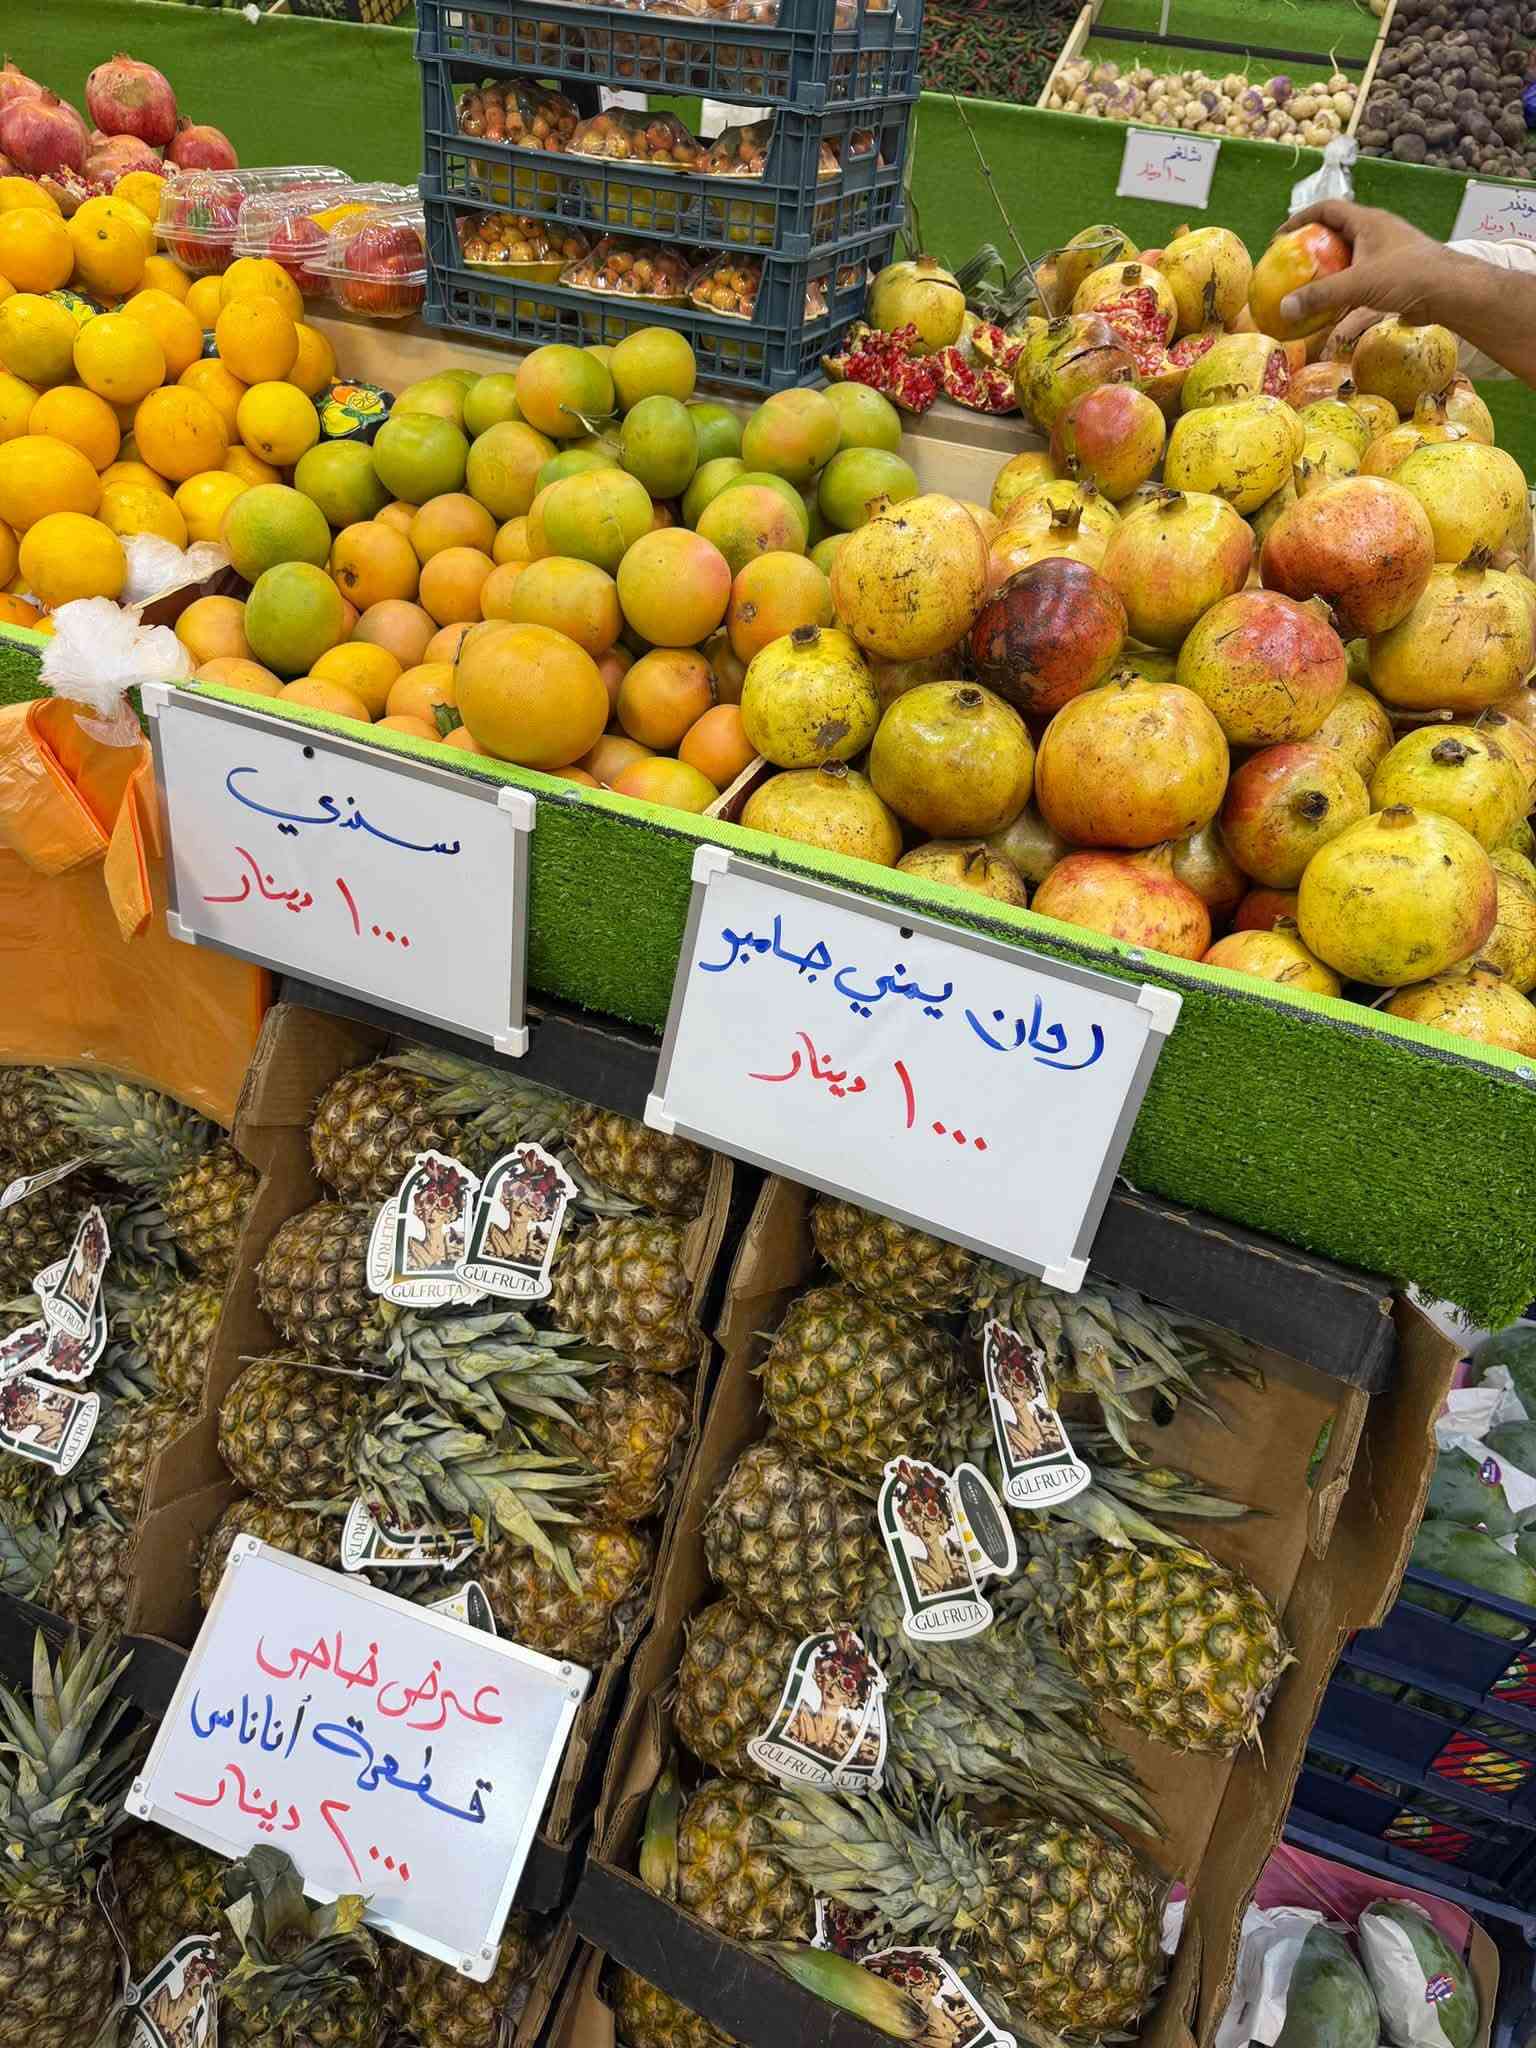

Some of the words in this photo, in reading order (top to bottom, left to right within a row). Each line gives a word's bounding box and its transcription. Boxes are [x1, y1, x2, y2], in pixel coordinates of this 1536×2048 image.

[1472, 214, 1505, 236] دينار
[226, 766, 462, 856] سندي
[203, 846, 314, 913] دينار
[335, 877, 412, 949] ١٠٠٠
[698, 914, 833, 984] جامبو
[833, 963, 955, 1020] يمني
[747, 1031, 867, 1098] دينار
[965, 993, 1105, 1072] رمان
[893, 1060, 989, 1153] ١٠٠٠
[255, 1630, 379, 1690] خاص
[376, 1659, 504, 1731] عرض
[190, 1687, 313, 1760] أناناس
[174, 1764, 301, 1833] دينار
[312, 1715, 494, 1825] قطعة
[319, 1799, 411, 1883] ٢٠٠٠
